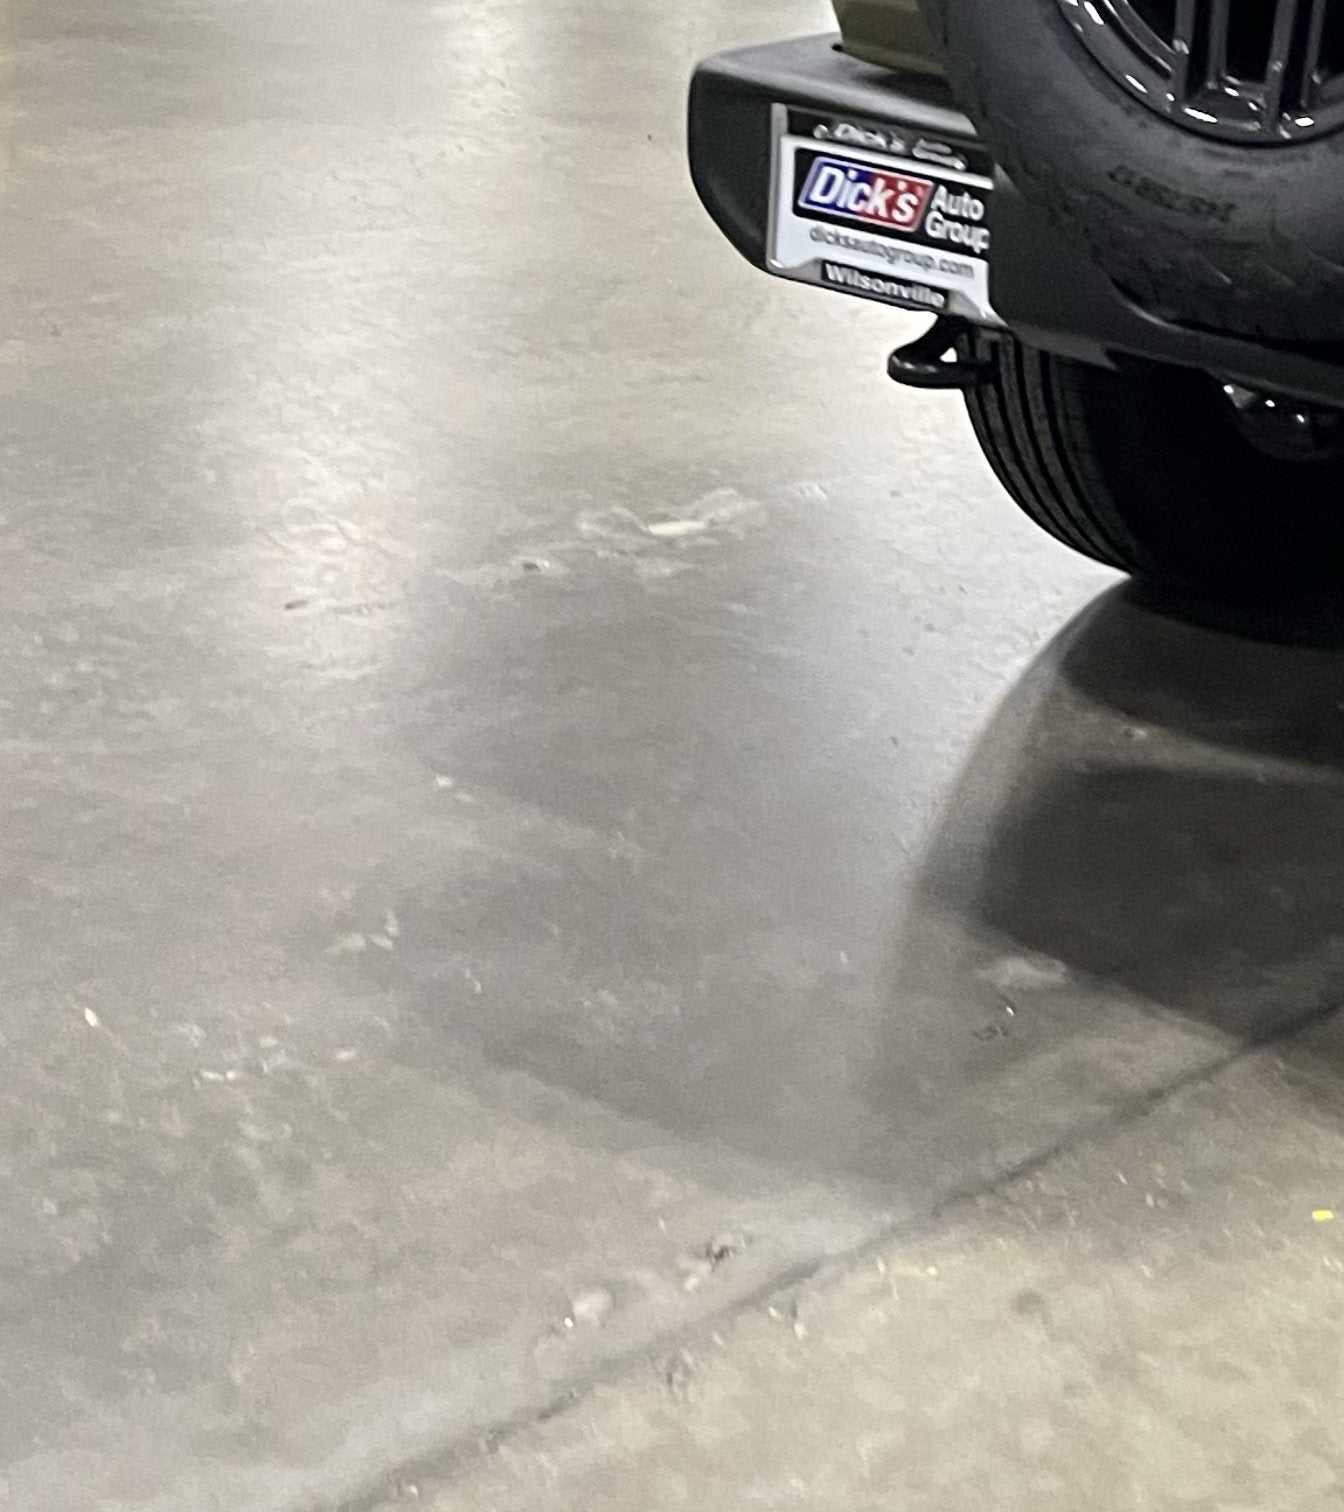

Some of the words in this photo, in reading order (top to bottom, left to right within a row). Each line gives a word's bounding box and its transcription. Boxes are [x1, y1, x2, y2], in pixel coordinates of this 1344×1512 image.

[809, 166, 919, 223] Dick's
[931, 184, 984, 220] Auto
[925, 210, 990, 253] Group
[825, 262, 945, 308] Wilsonville
